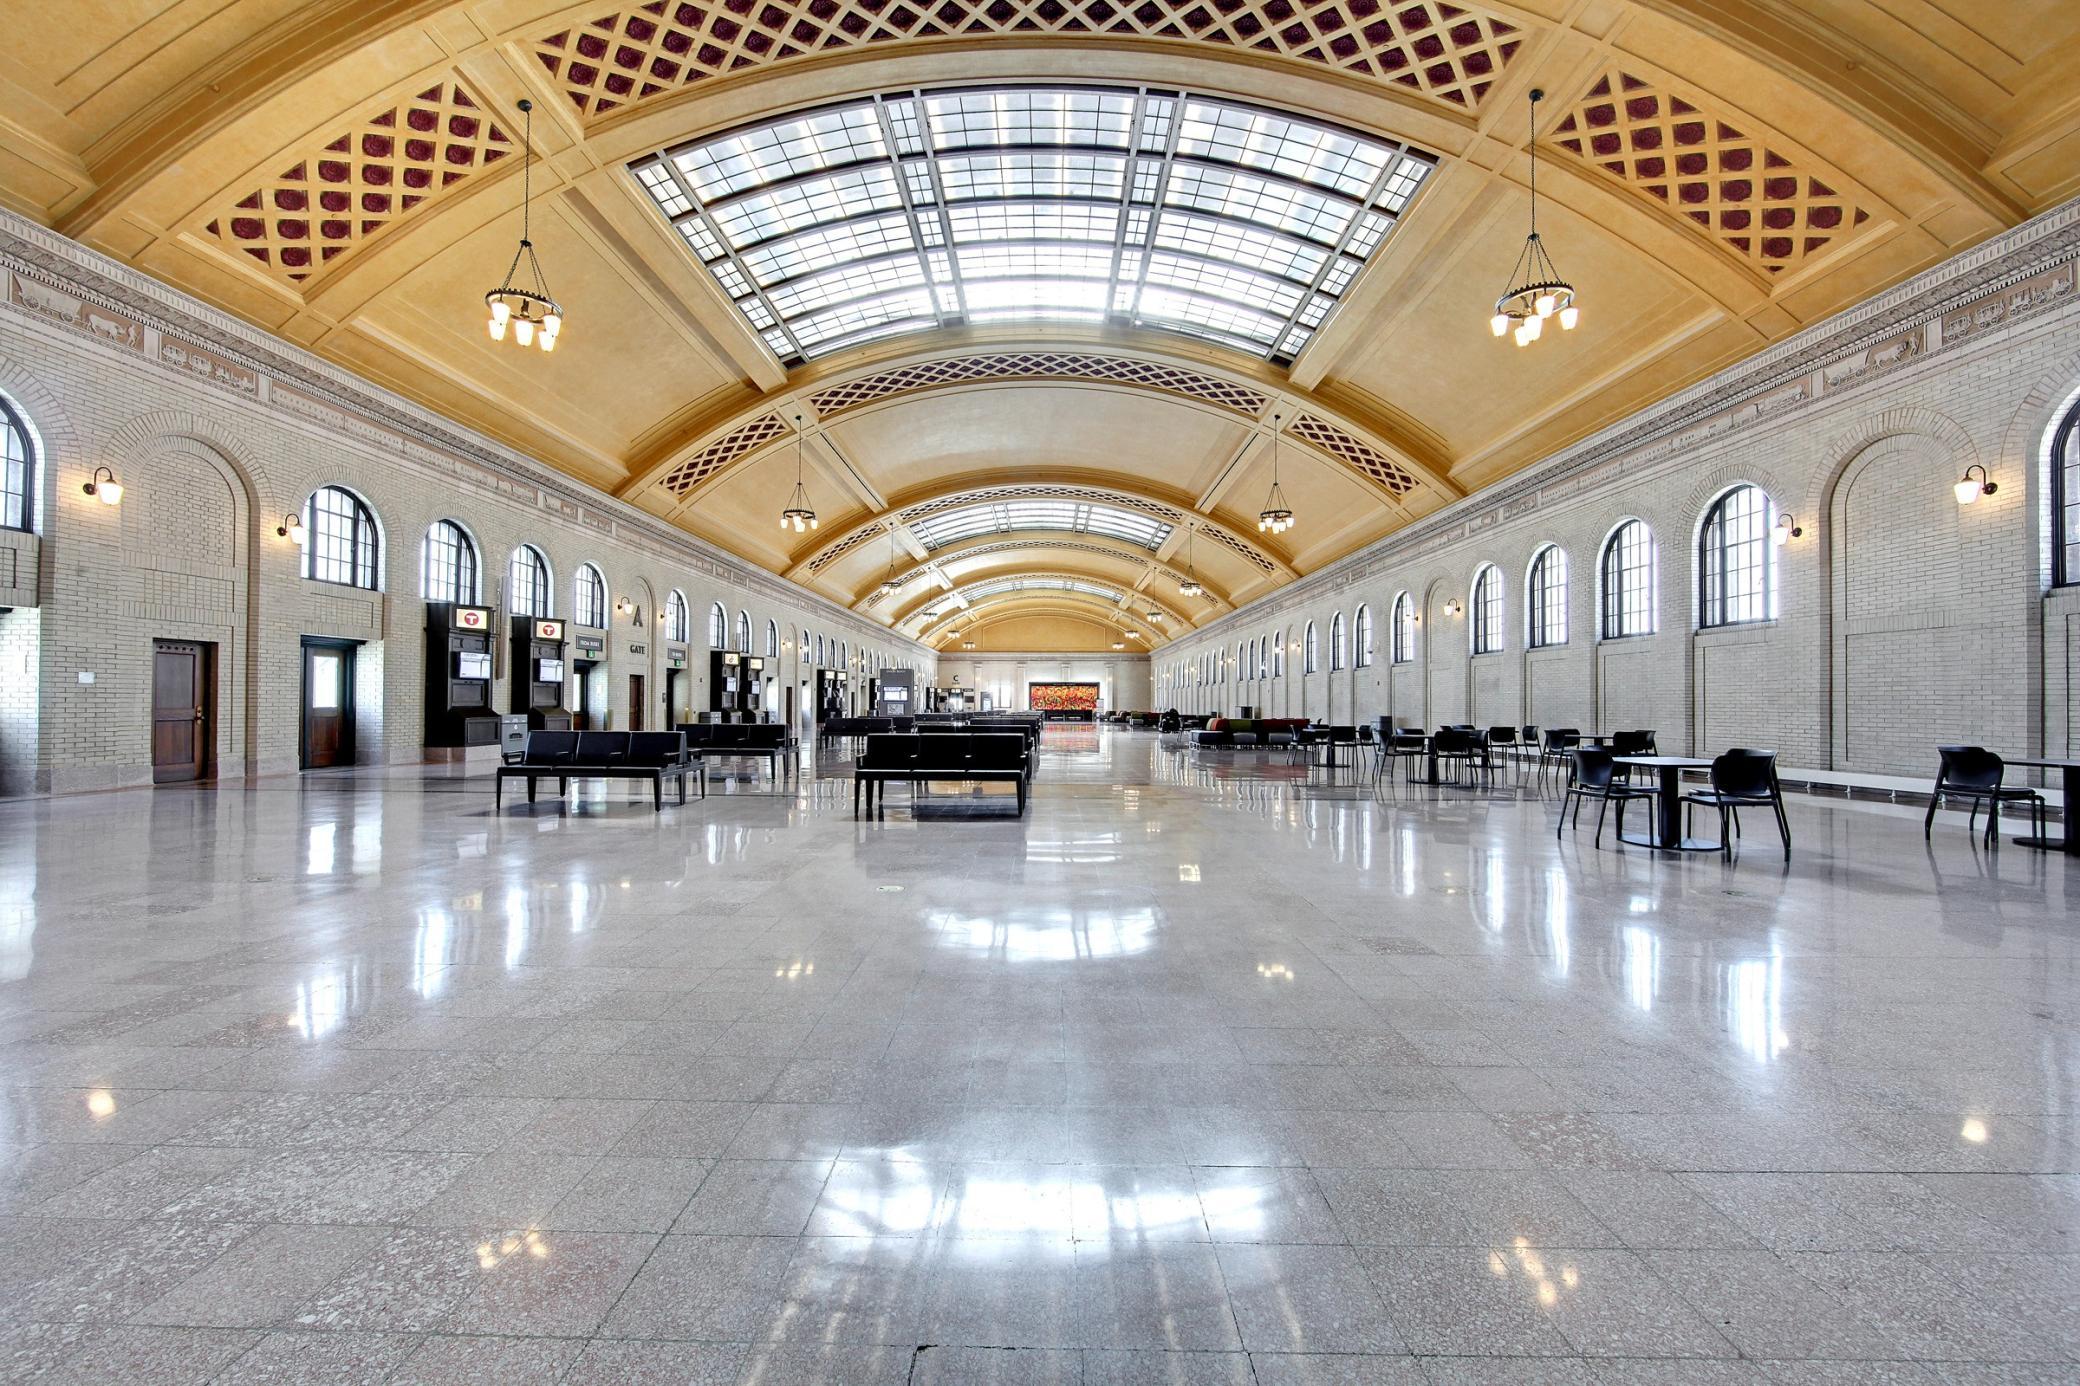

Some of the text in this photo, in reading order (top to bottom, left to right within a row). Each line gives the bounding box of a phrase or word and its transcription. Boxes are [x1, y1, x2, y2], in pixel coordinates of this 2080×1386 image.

[465, 615, 478, 625] T
[632, 605, 643, 627] A
[543, 626, 554, 635] T
[630, 645, 645, 654] GATE
